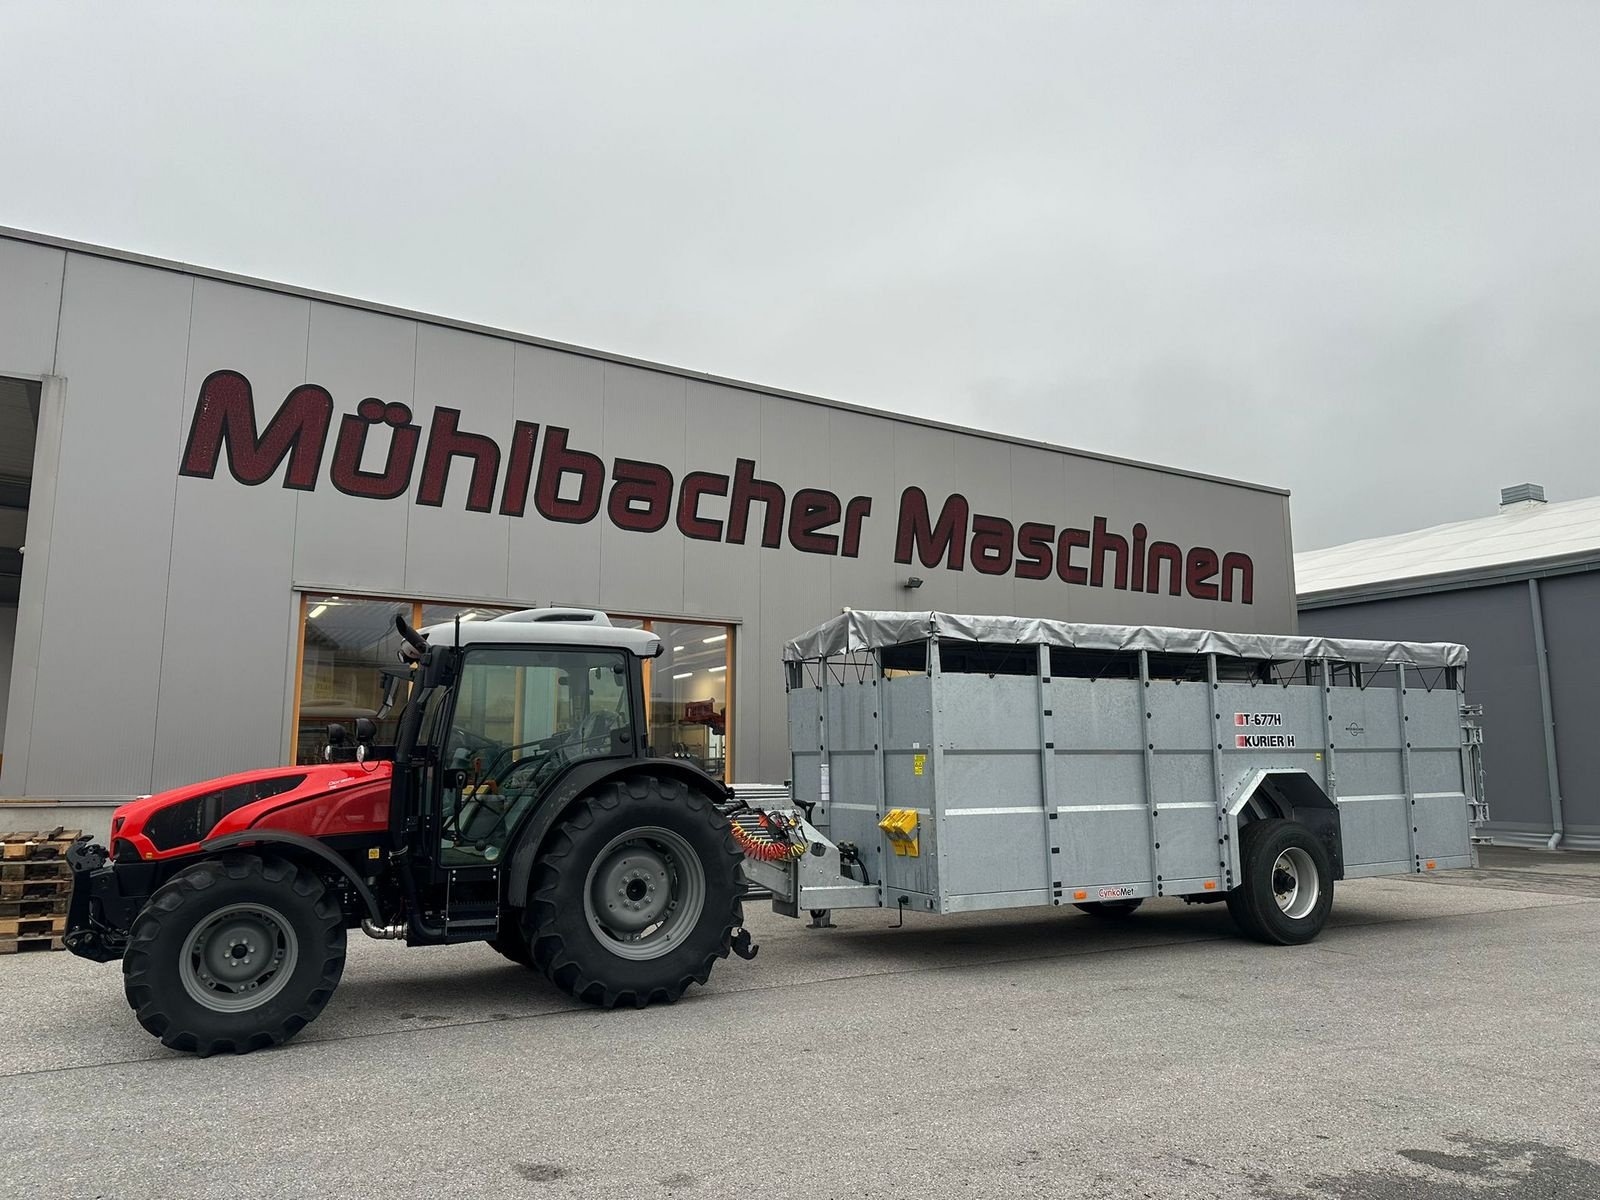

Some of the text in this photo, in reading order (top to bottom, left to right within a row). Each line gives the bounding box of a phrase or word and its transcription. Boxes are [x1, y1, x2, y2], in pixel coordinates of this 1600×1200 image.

[178, 369, 1253, 605] Mühlbacher Maschinen
[1244, 714, 1281, 725] T-677H
[1244, 735, 1295, 747] KURIER H
